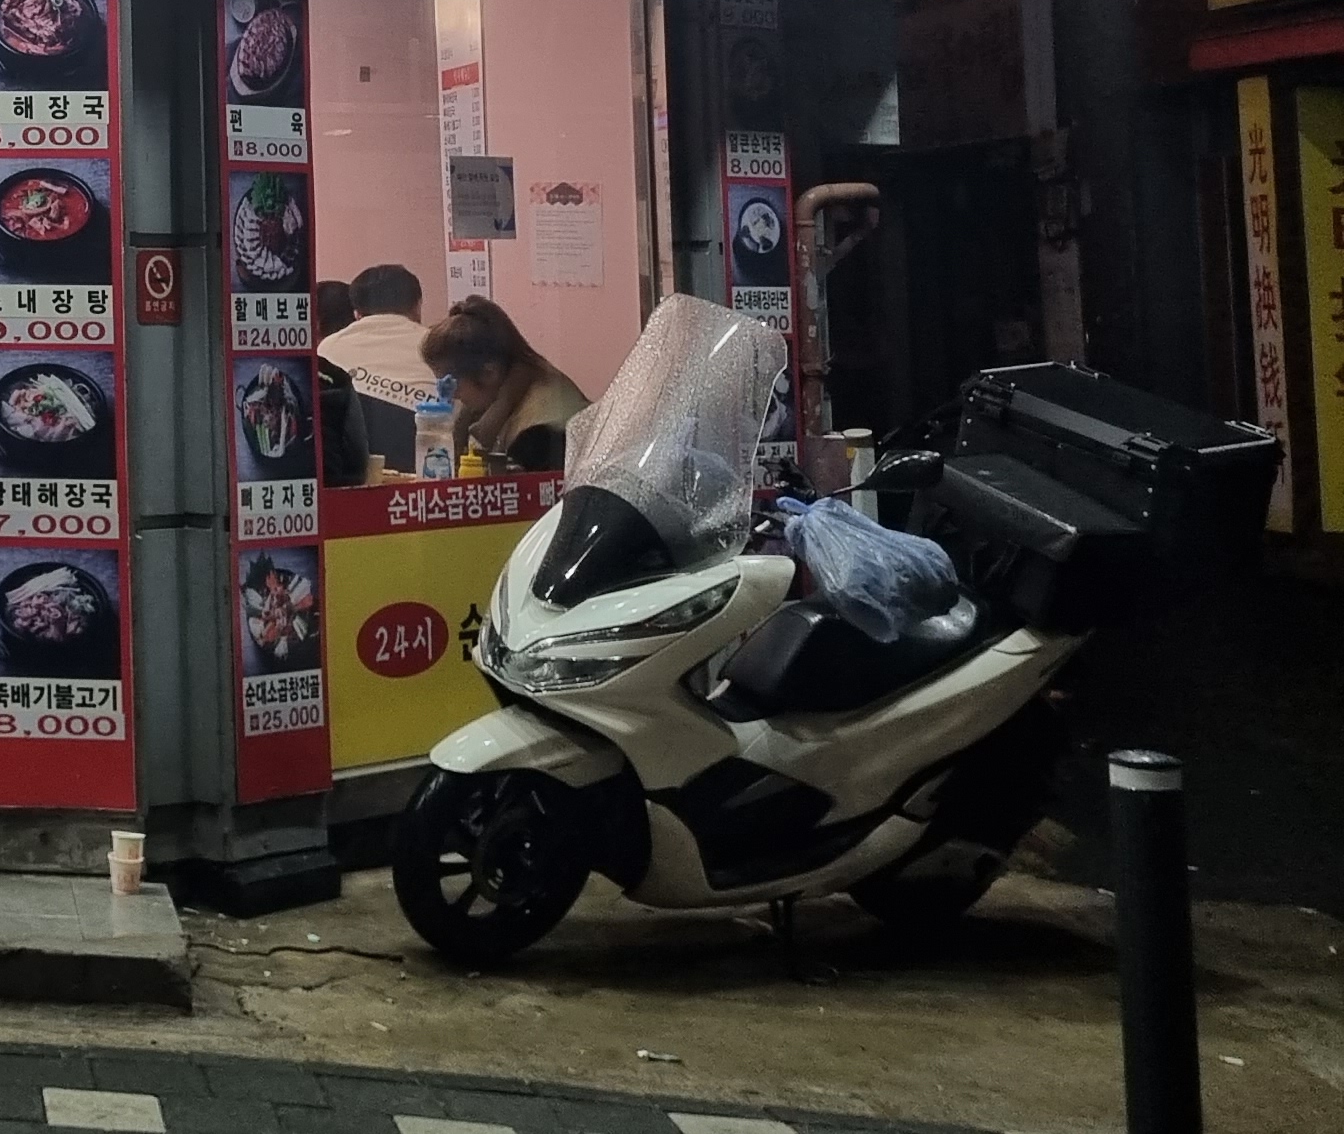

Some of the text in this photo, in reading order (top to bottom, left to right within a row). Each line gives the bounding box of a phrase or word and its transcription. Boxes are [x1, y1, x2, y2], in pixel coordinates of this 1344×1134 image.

[246, 141, 302, 158] 8,000
[728, 132, 784, 155] 얼큰순대국
[731, 159, 782, 176] 8,000
[250, 327, 308, 348] 24,000
[388, 482, 520, 525] 순대소곱창전골
[256, 514, 314, 536] 26,000
[375, 616, 433, 661] 24시
[245, 674, 321, 708] 순대소곱창전골
[261, 707, 320, 730] 25,000
